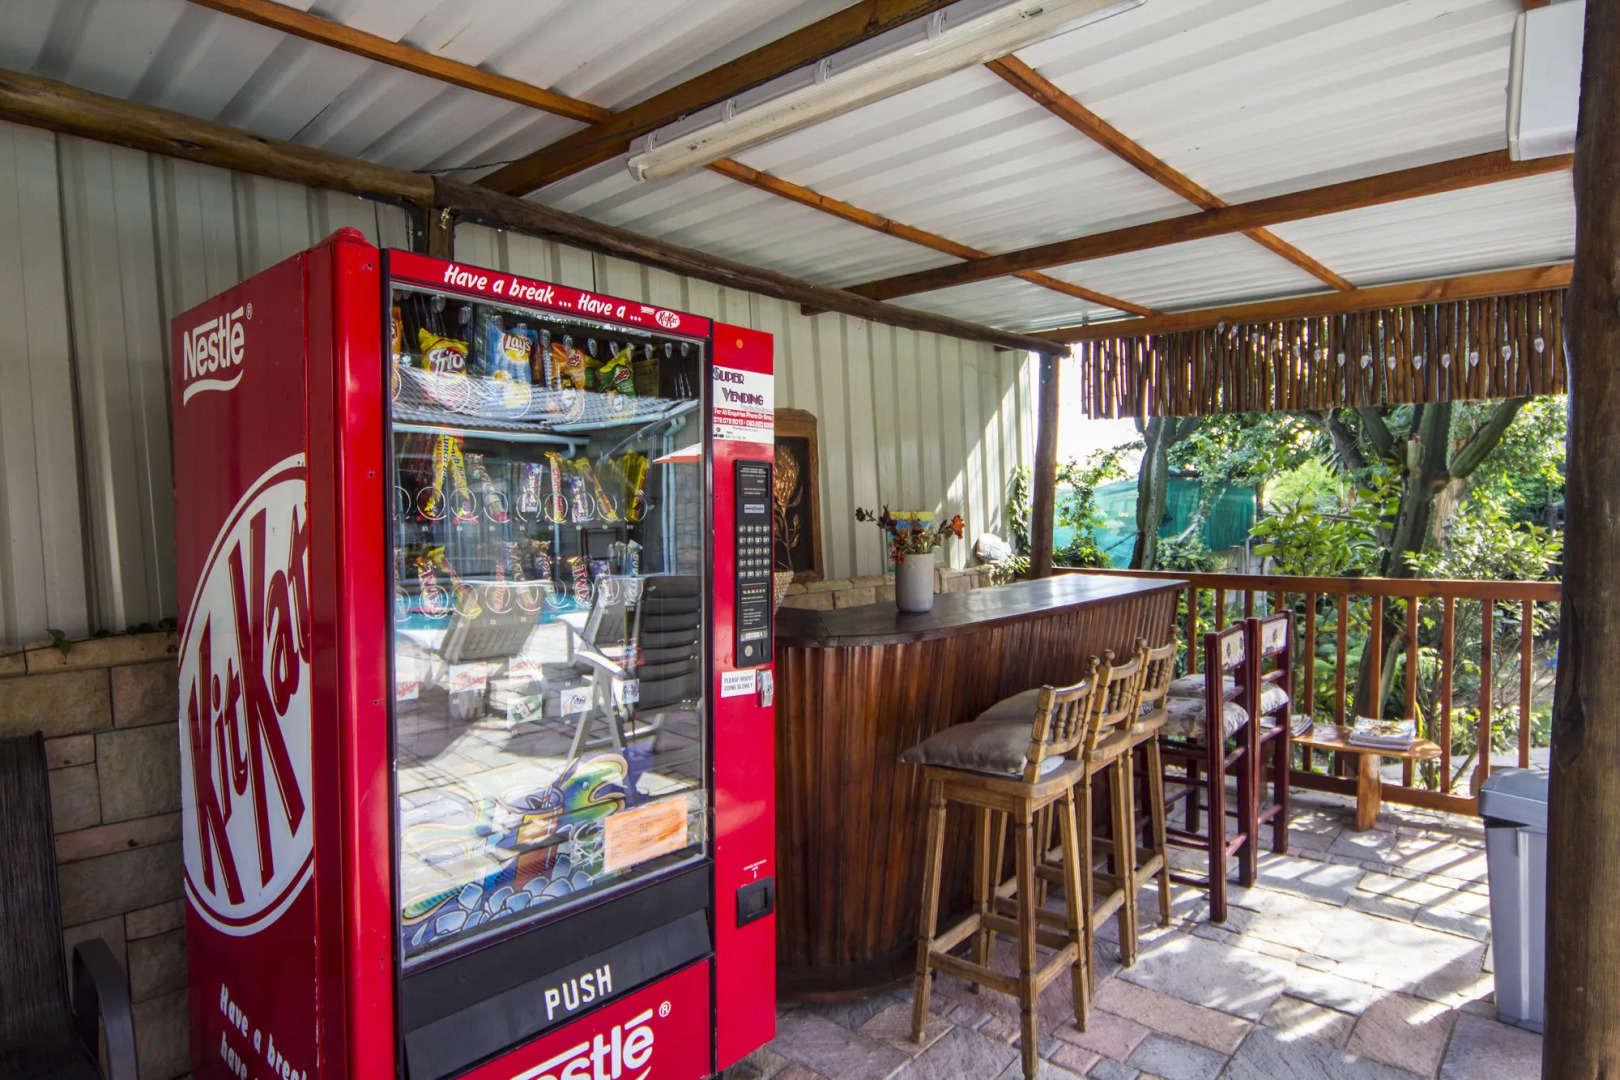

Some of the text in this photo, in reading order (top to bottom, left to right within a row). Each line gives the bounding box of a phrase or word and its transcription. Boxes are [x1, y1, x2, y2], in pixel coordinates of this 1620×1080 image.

[443, 264, 488, 290] Have
[492, 279, 503, 294] a
[508, 278, 555, 305] break
[577, 293, 613, 318] Have
[616, 305, 626, 318] a
[657, 311, 679, 328] KitKat
[183, 306, 245, 382] Nestlé
[721, 387, 764, 406] VENDING
[187, 503, 311, 906] KitKat
[220, 982, 249, 1038] Have
[253, 1028, 262, 1055] a
[544, 964, 613, 1021] PUSH
